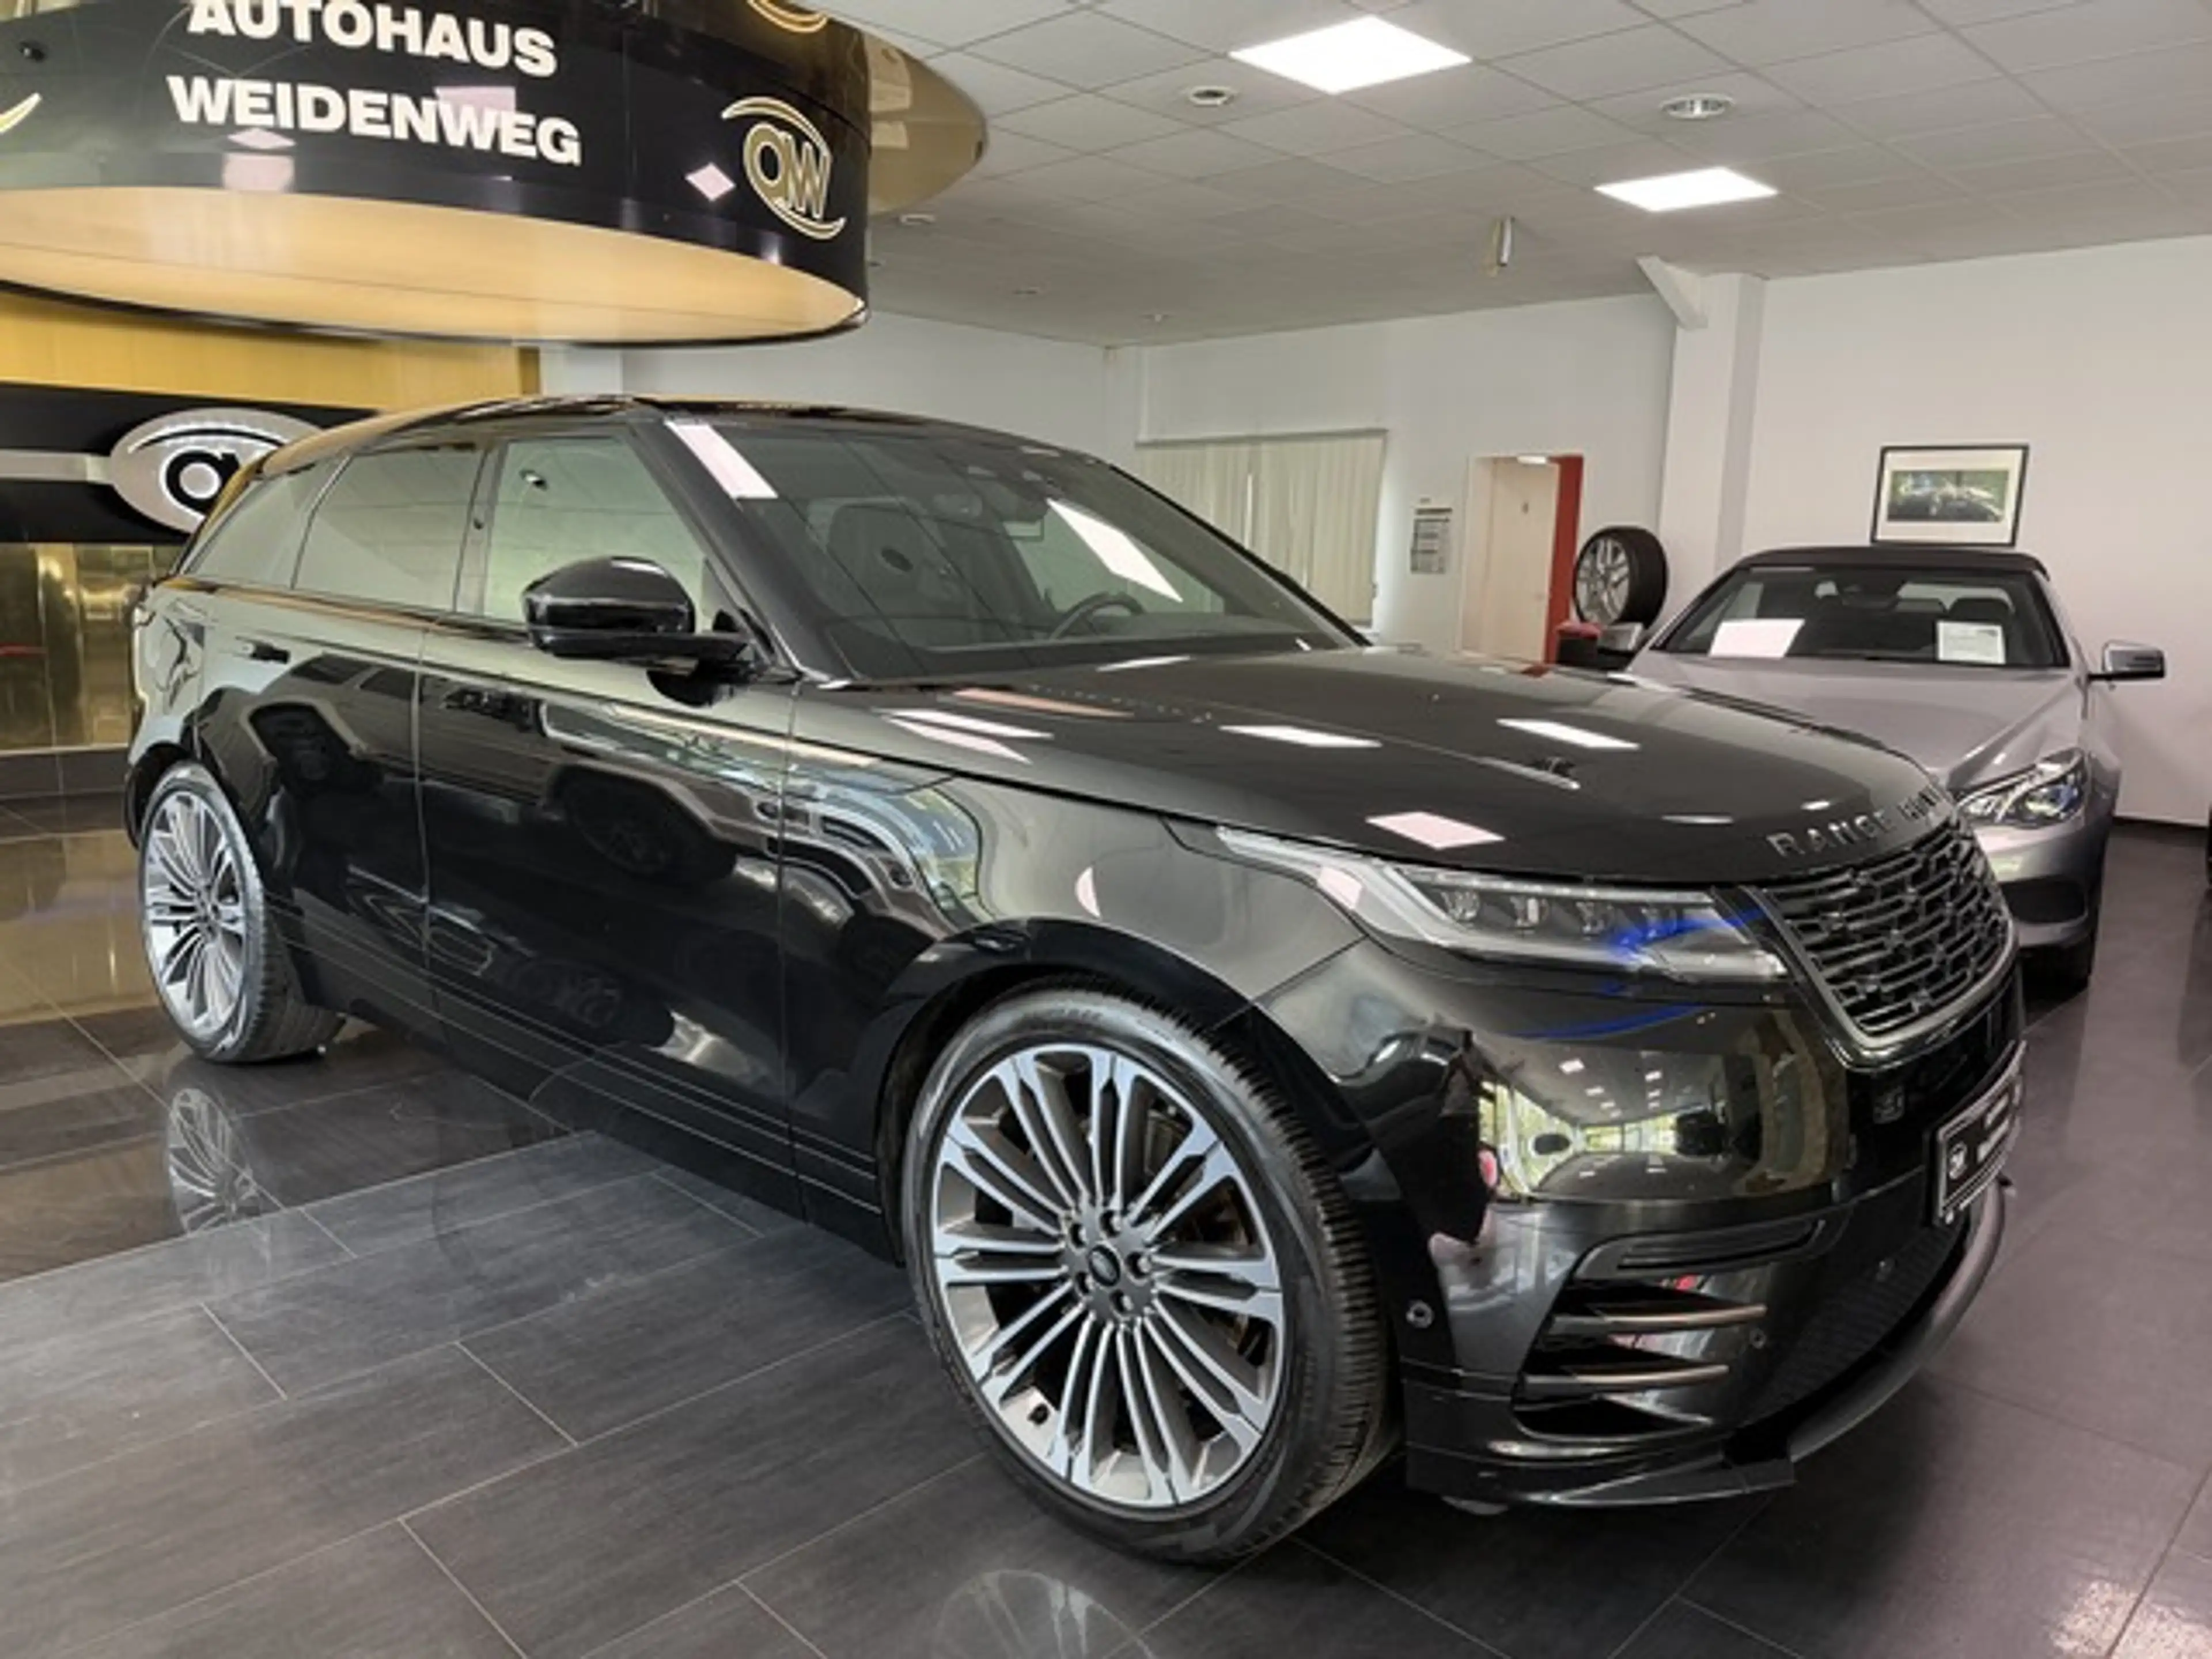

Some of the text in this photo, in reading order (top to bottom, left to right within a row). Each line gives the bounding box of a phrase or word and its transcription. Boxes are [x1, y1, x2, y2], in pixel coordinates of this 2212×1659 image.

[187, 0, 558, 77] AUTOHAUS
[166, 75, 582, 166] WEIDENWEG
[1765, 809, 1894, 856] RANGE
